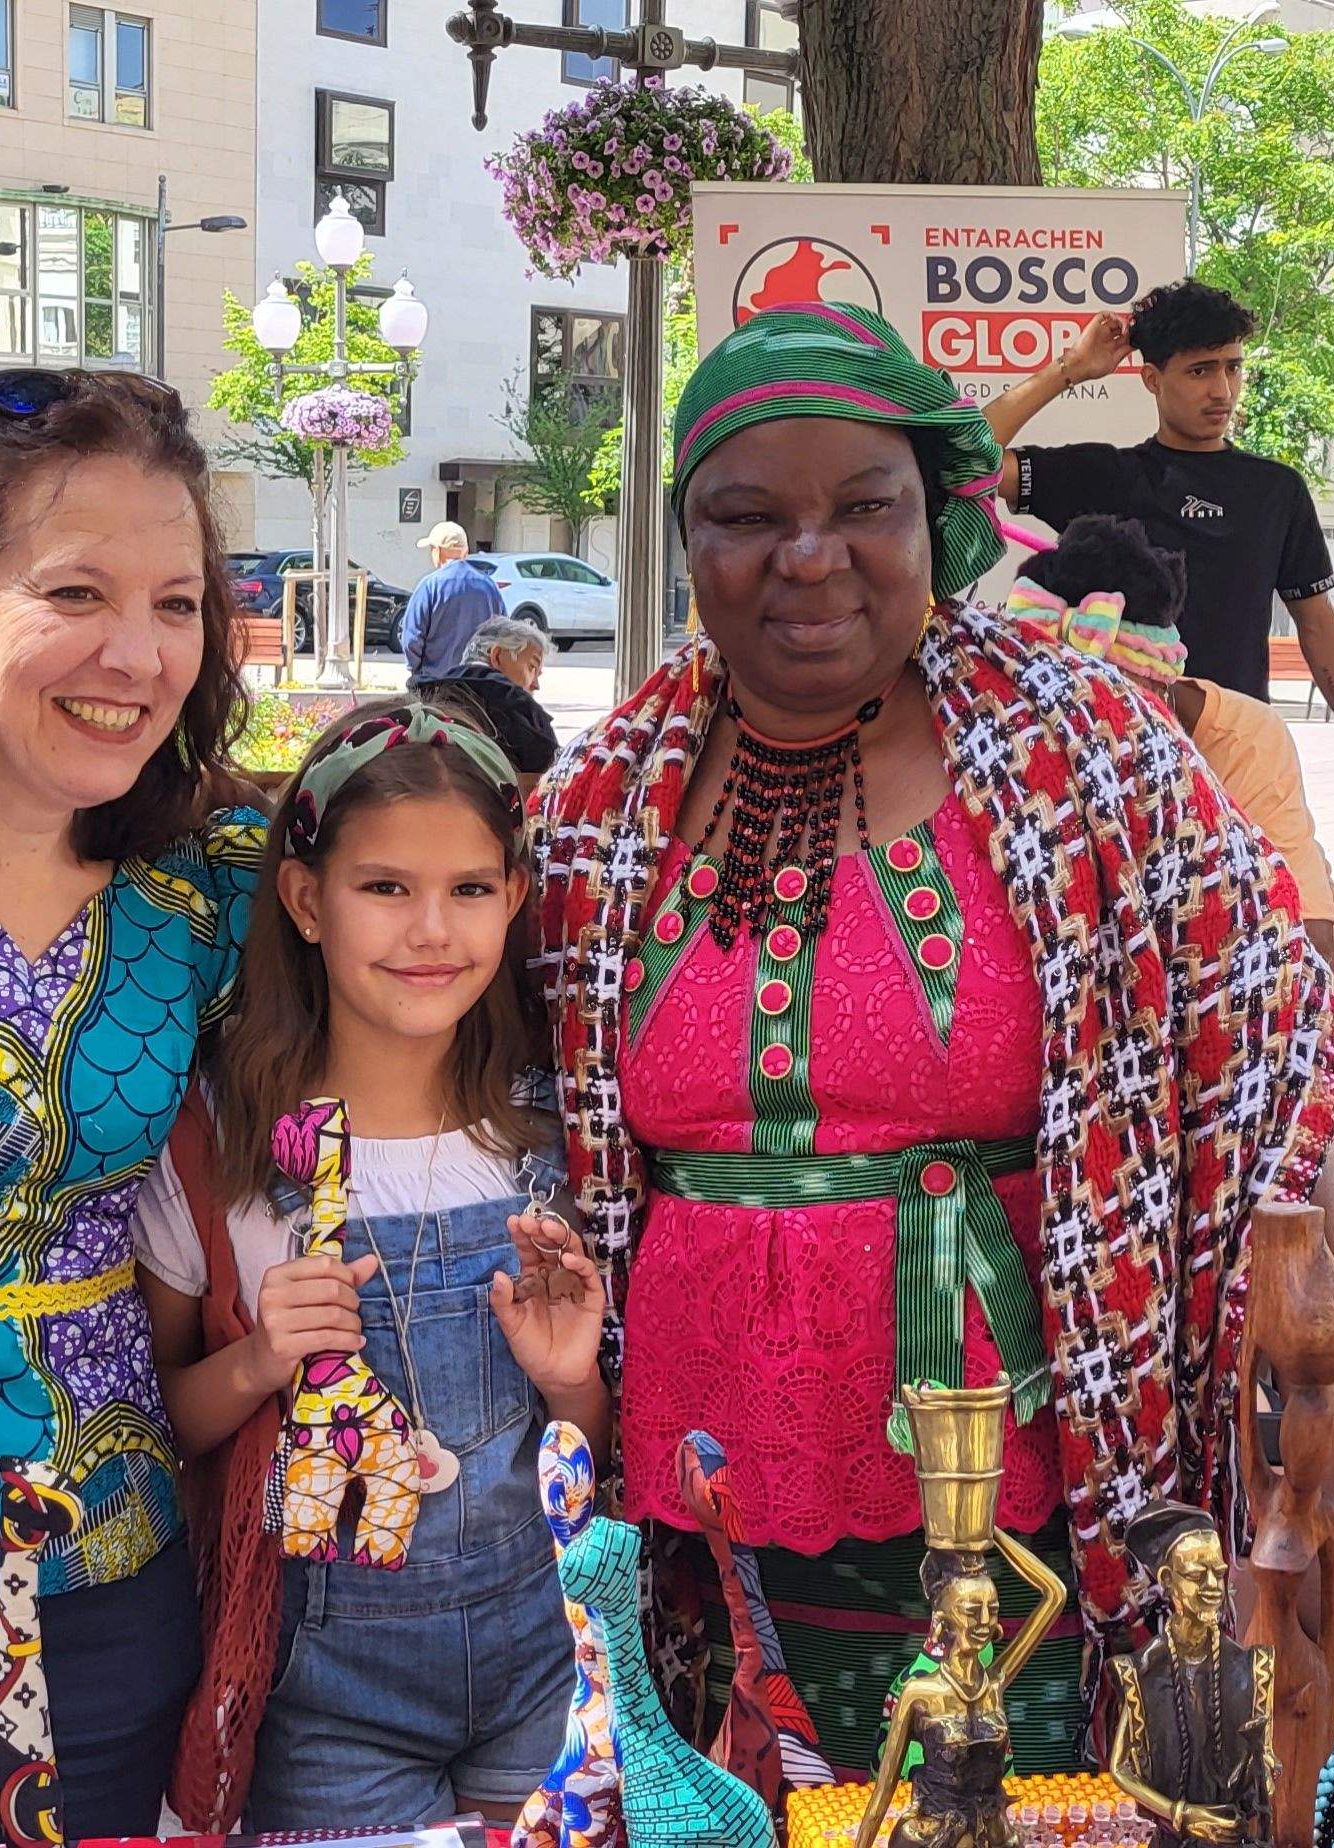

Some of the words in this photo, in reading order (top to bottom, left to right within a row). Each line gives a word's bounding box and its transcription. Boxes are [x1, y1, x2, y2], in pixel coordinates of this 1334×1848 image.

[925, 228, 1103, 249] ENTARACHEN
[926, 256, 1139, 305] BOSCO
[1020, 458, 1032, 496] TENTH
